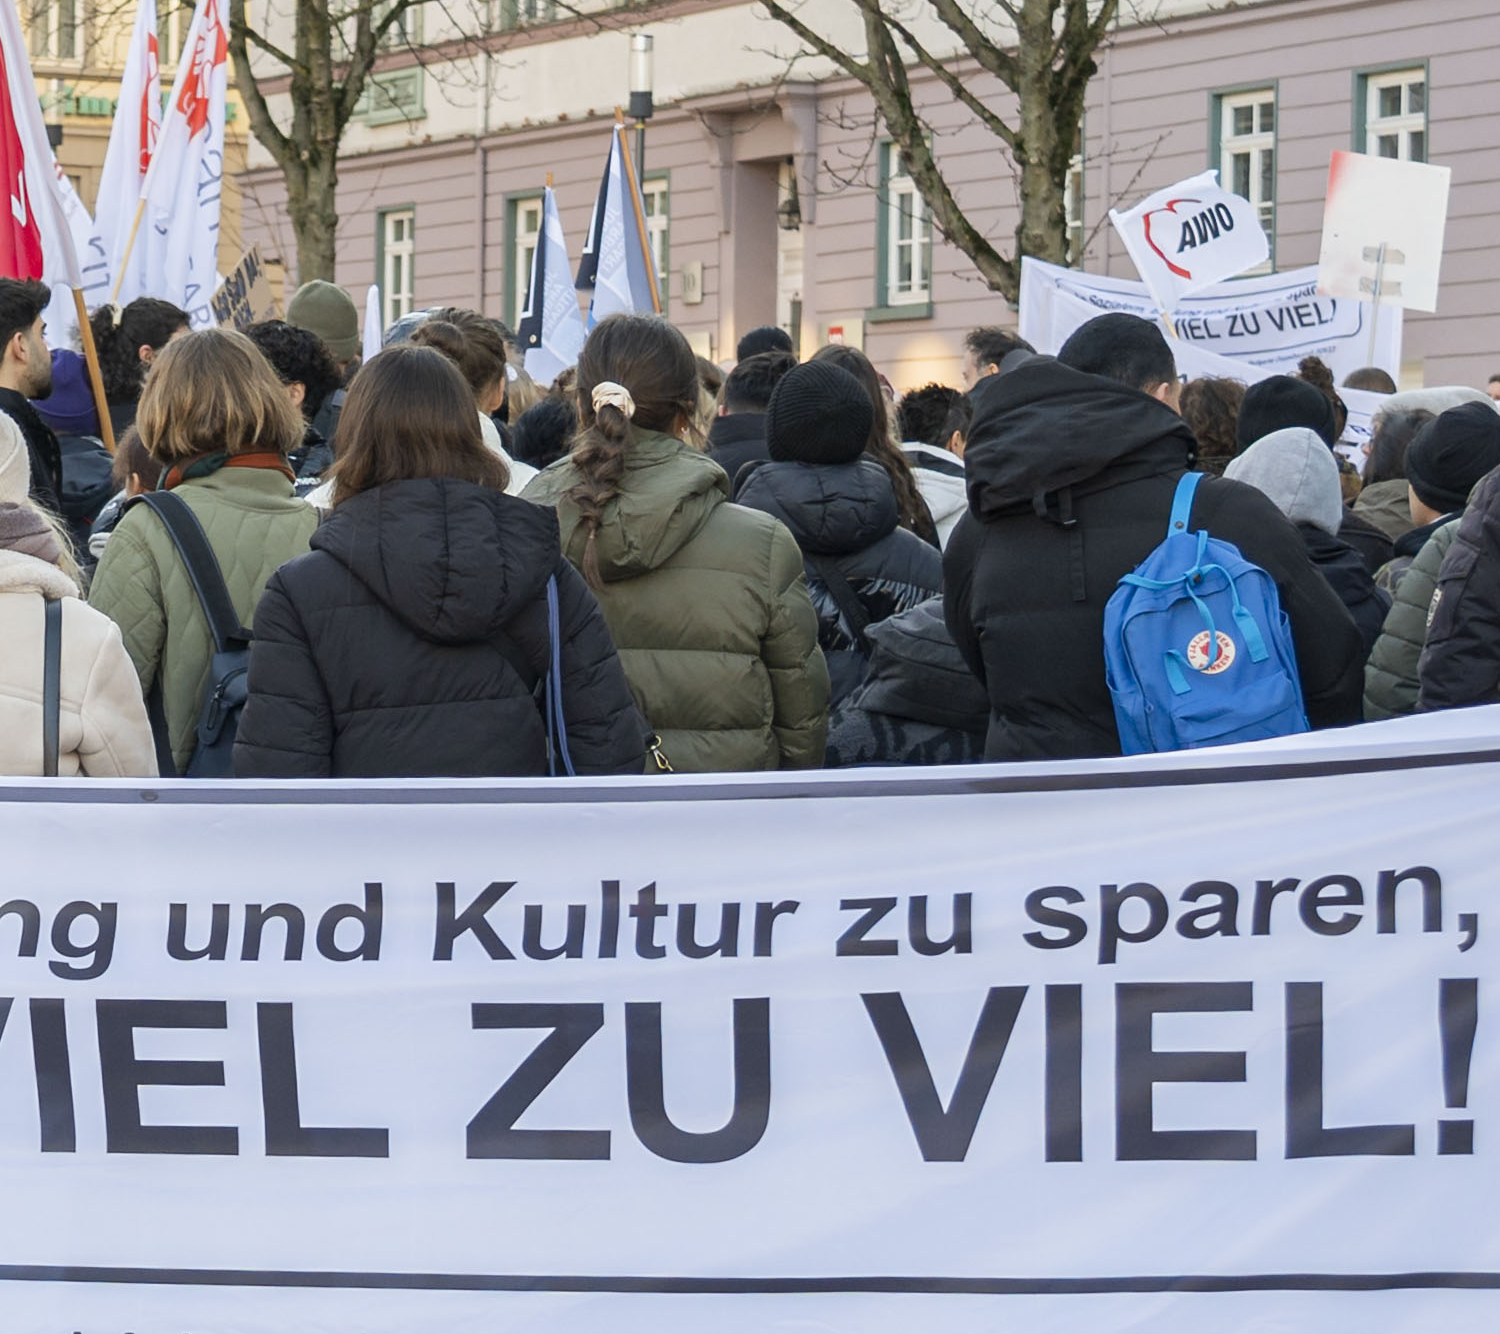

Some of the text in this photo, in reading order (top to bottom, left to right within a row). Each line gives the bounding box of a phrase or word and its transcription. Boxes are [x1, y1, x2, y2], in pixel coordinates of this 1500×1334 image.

[1177, 201, 1234, 254] AWO
[683, 273, 696, 293] 10
[1228, 312, 1261, 338] ZU
[166, 882, 384, 962] und
[432, 879, 801, 961] Kultur
[835, 892, 973, 957] zu
[1022, 865, 1479, 965] sparen,
[466, 996, 772, 1164] ZU
[859, 977, 1479, 1163] VIEL!
